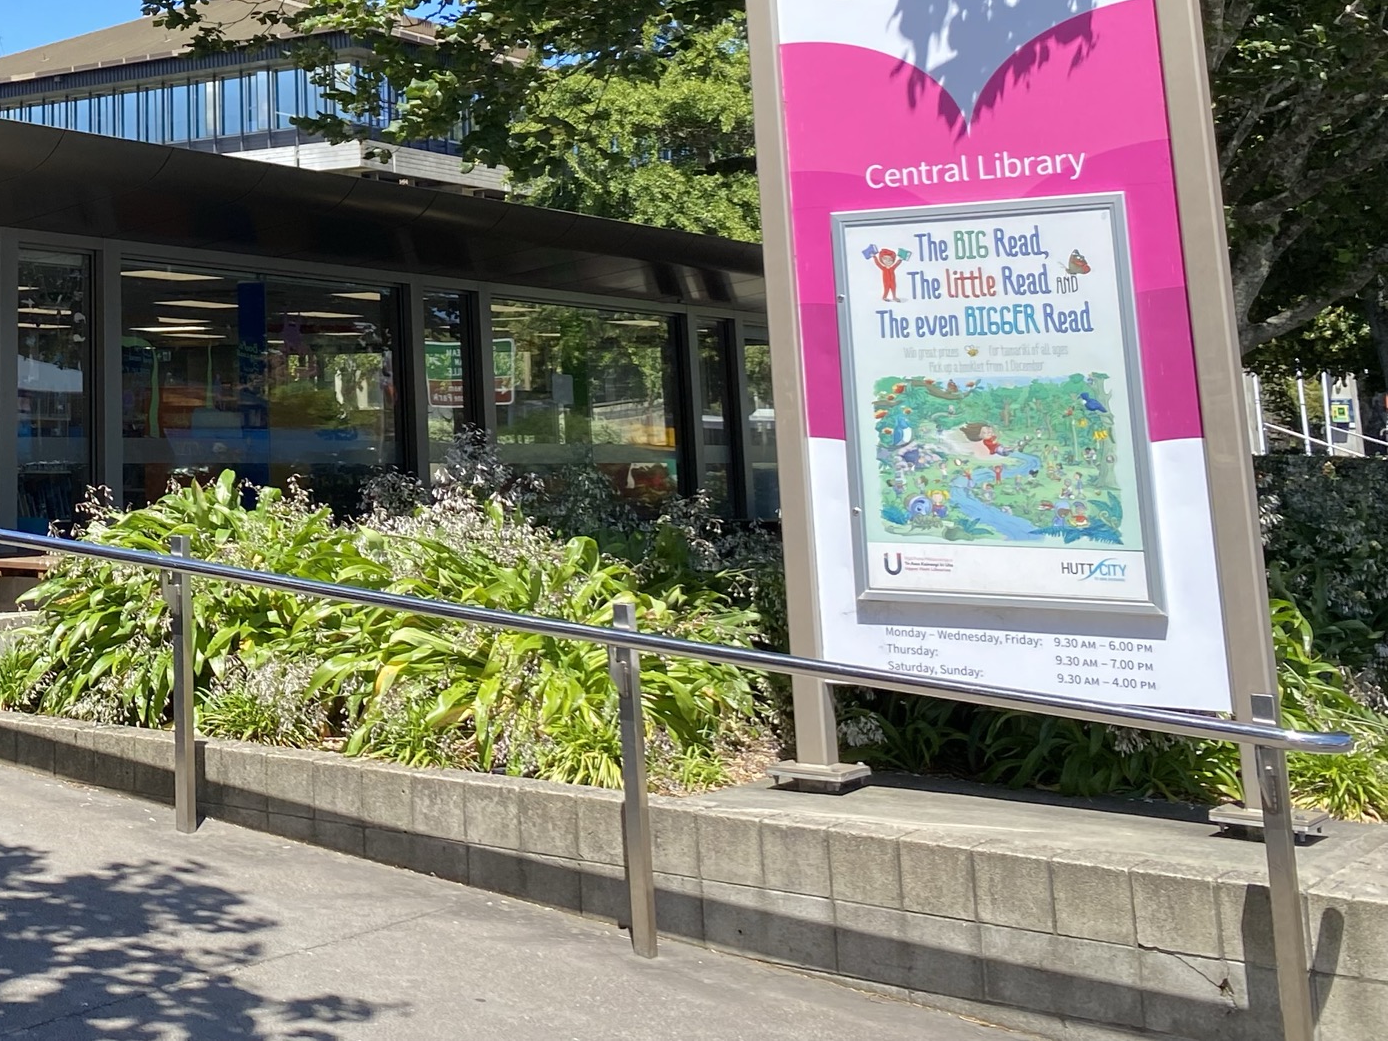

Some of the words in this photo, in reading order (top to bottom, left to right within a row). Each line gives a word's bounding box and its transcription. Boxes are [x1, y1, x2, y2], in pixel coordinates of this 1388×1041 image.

[865, 155, 970, 189] Central
[978, 151, 1087, 181] Library
[914, 232, 949, 262] The
[953, 230, 989, 260] BIG
[993, 225, 1049, 260] Read,
[906, 270, 942, 300] The
[945, 266, 997, 299] little
[1001, 263, 1052, 296] Read
[1055, 275, 1079, 294] AND
[875, 309, 910, 339] The
[915, 312, 960, 338] even
[964, 303, 1041, 337] BIGGER
[1042, 300, 1095, 334] Read
[1061, 562, 1094, 575] HUTT
[1099, 563, 1127, 577] CITY
[885, 627, 926, 640] Monday
[937, 630, 1002, 645] Wednesday,
[1005, 633, 1043, 648] Friday:
[1053, 637, 1078, 648] 9.30
[1080, 640, 1096, 649] AM
[1108, 641, 1133, 652] 6.00
[1136, 644, 1153, 653] PM
[887, 643, 938, 658] Thursday:
[1055, 655, 1080, 666] 9.30
[1082, 659, 1098, 667] AM
[1110, 659, 1134, 670] 7.00
[1137, 662, 1153, 671] PM
[887, 660, 938, 676] Saturday,
[940, 664, 984, 677] Sunday:
[1057, 673, 1081, 685] 9.30
[1084, 677, 1100, 686] AM
[1112, 677, 1137, 689] 4.00
[1140, 681, 1156, 690] PM
